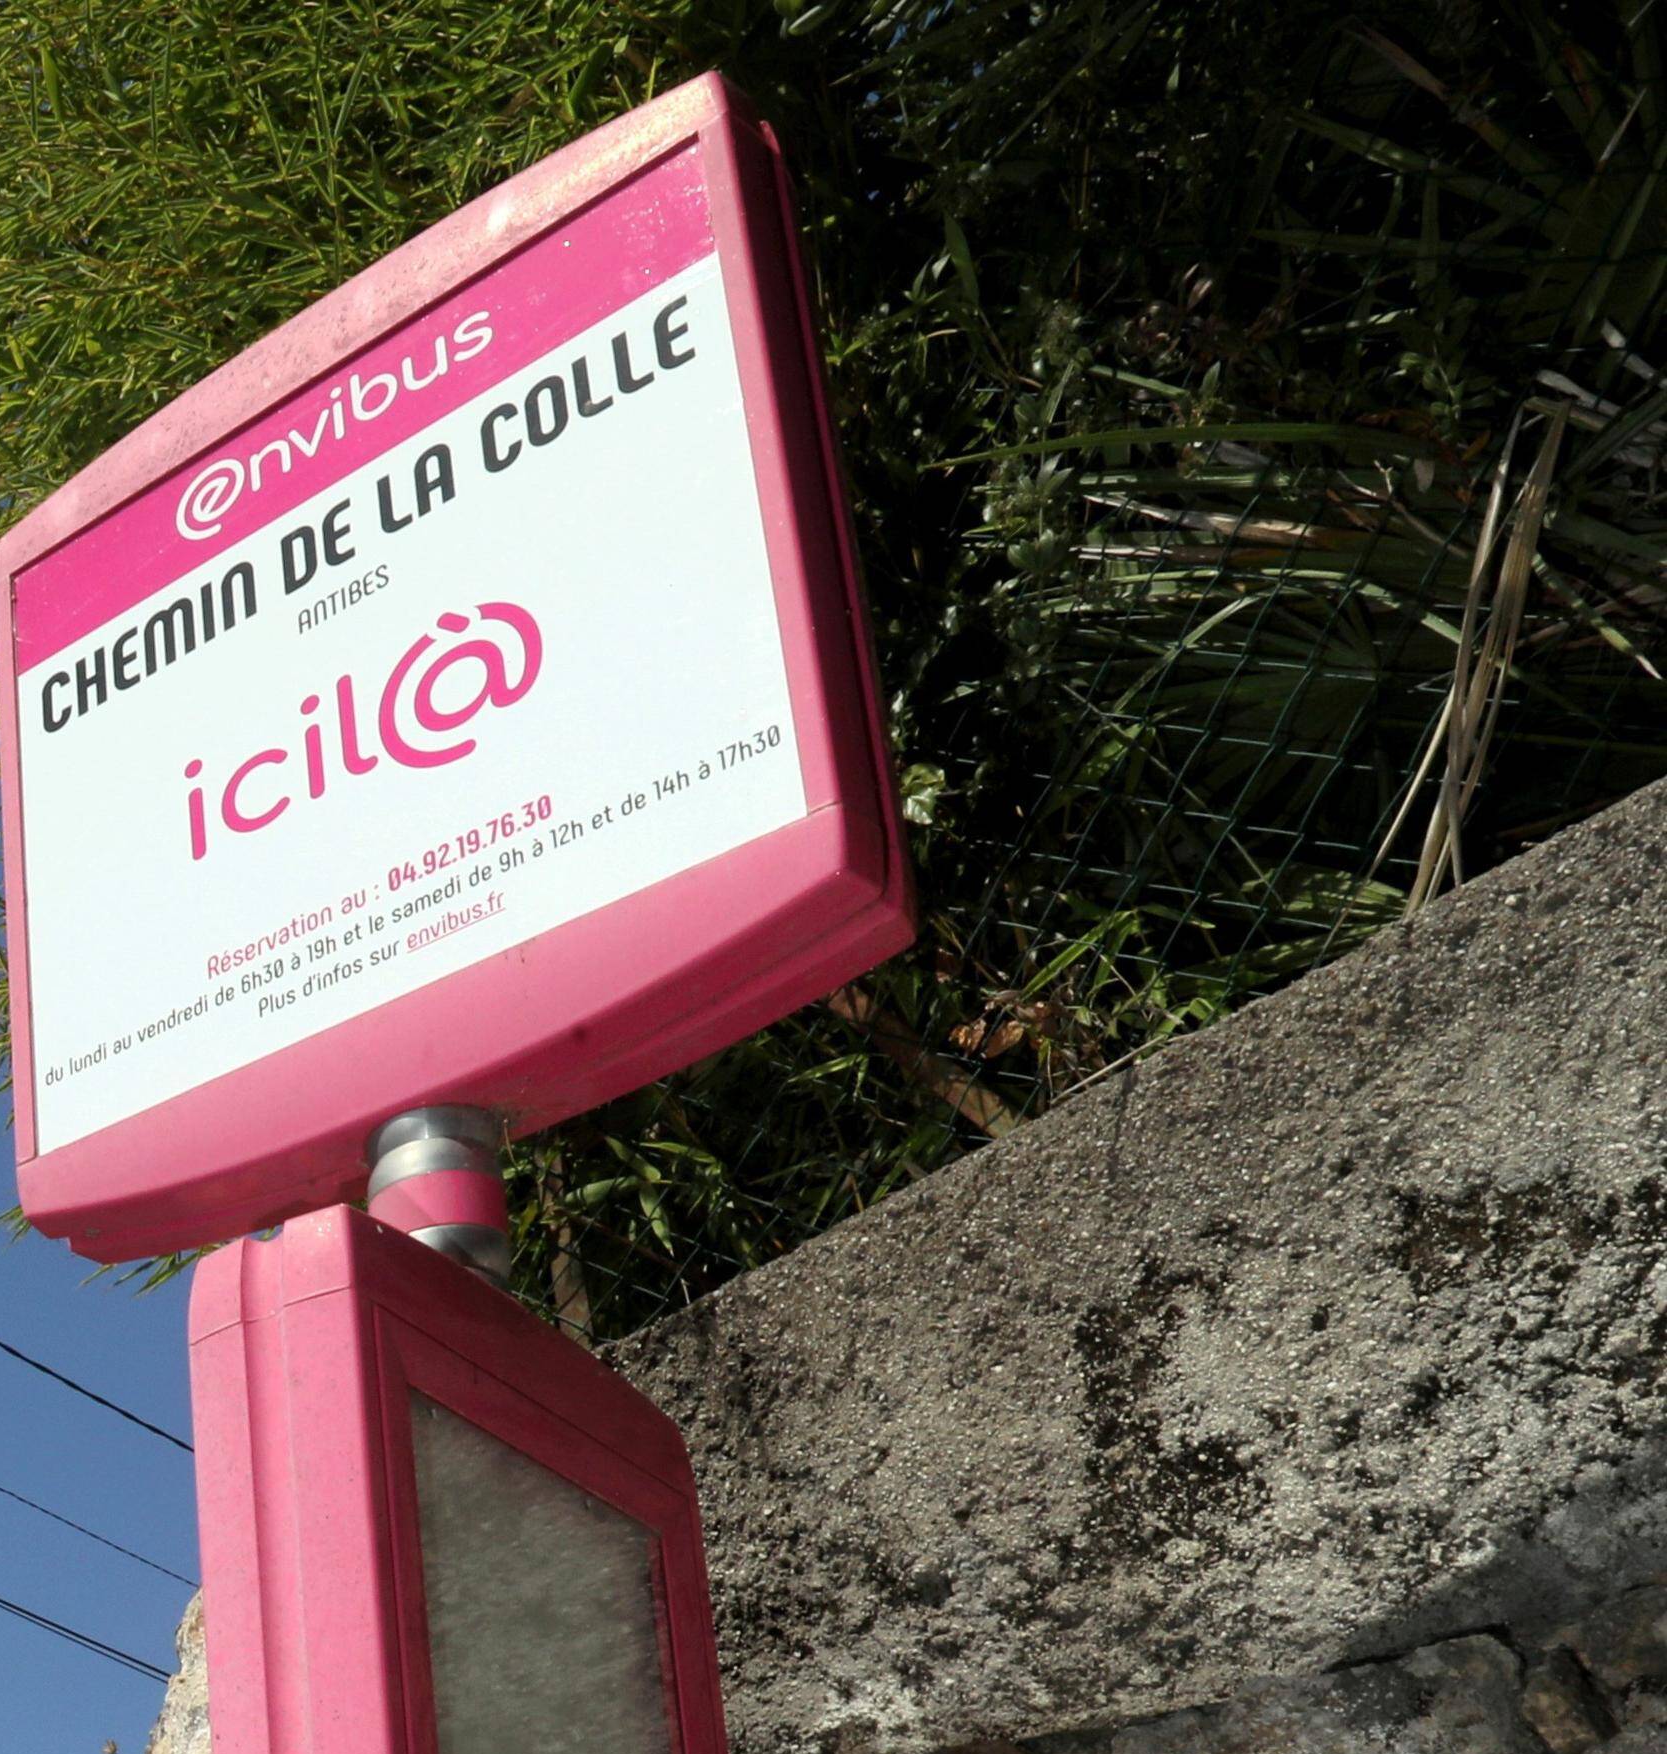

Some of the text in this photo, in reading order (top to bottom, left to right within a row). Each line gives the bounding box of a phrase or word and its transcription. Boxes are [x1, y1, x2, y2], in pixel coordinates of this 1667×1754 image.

[41, 295, 696, 733] CHEMIN DE LA COLLE
[298, 564, 389, 634] ANTIBES
[45, 724, 781, 1086] du lundi au vendredi de 6h30 à 19h et le samedi de 9h à 12h et de 14h à 17h30
[207, 906, 333, 980] Réservation
[341, 889, 366, 915] au
[388, 794, 552, 892] 04.92.19.76.30
[257, 890, 505, 1017] Plus d'infos sur envibus.fr
